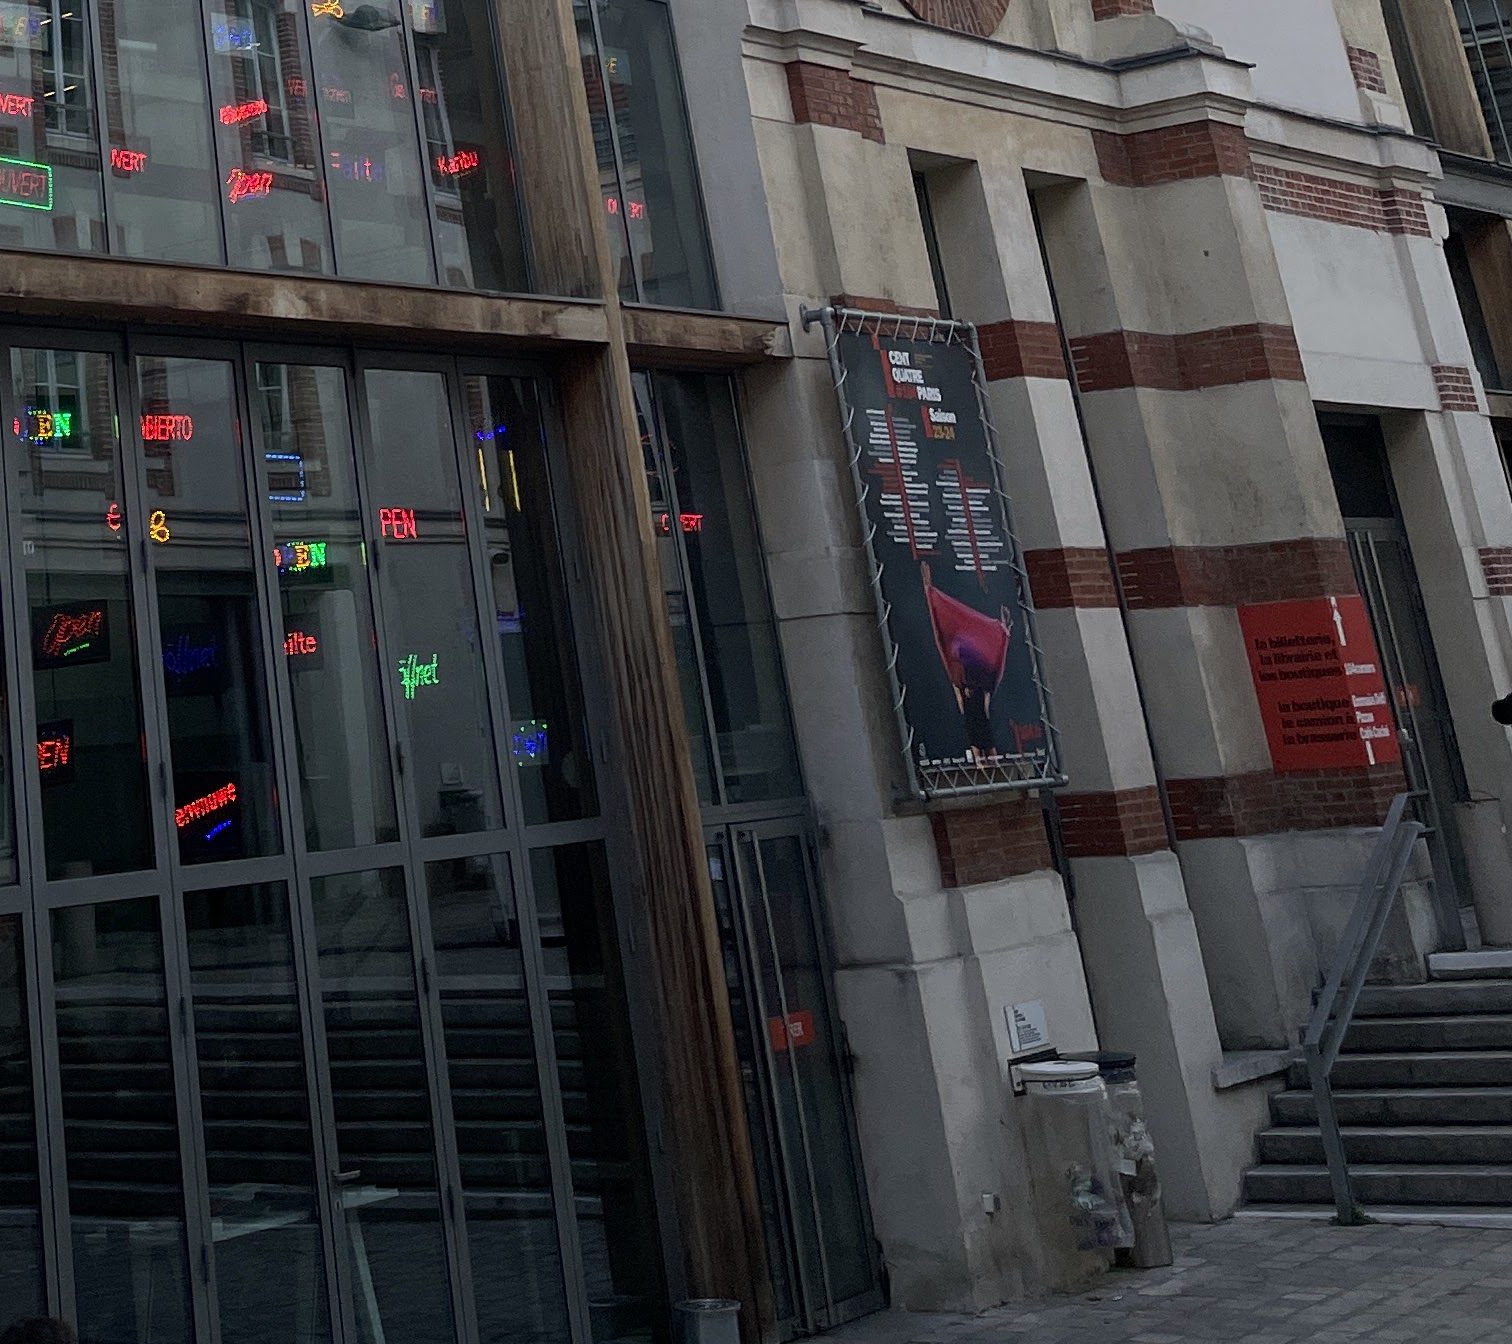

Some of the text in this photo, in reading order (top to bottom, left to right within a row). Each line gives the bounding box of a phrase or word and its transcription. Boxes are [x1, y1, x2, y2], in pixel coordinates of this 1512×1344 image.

[888, 350, 910, 366] CENT
[892, 367, 924, 384] QUATRE
[929, 407, 957, 424] Saison
[379, 508, 418, 539] PEN
